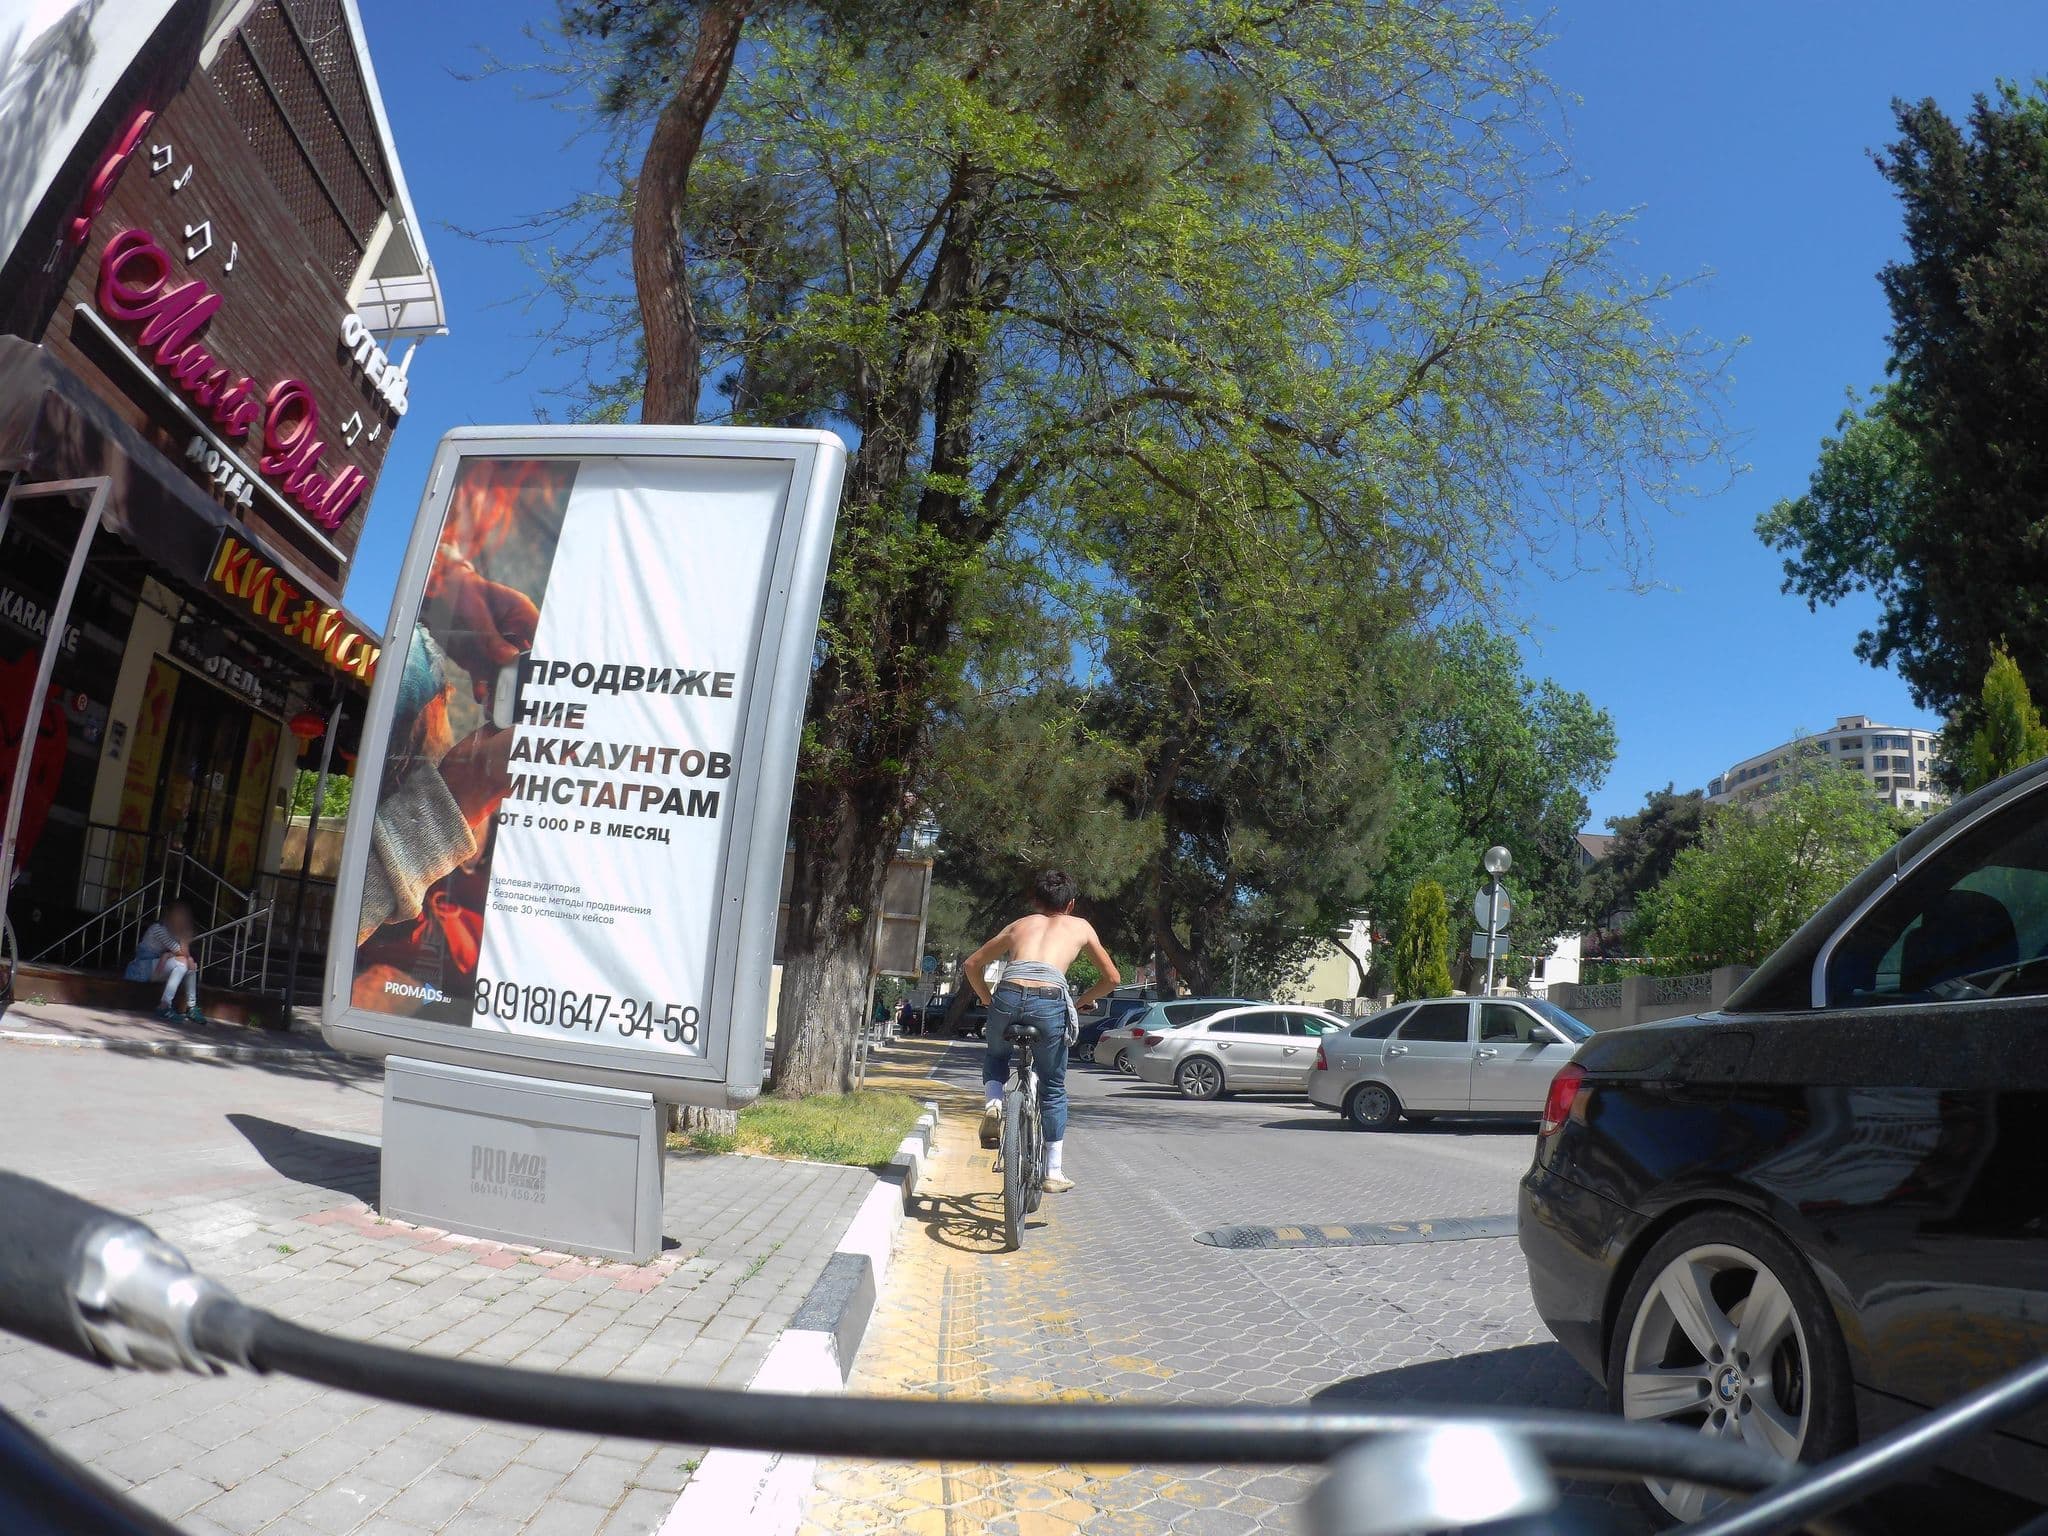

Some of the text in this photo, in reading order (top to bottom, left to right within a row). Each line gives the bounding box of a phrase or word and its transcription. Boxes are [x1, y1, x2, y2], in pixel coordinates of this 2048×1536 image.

[341, 313, 409, 416] ОТЕЛЬ
[0, 585, 81, 653] KARAKE
[527, 659, 736, 699] ПРОДВИЖЕ
[519, 699, 588, 730] НИЕ
[509, 736, 732, 780] АККАУНТОВ
[507, 773, 720, 819] ИНСТАГРАМ
[499, 812, 519, 827] ОТ
[523, 815, 533, 828] 5
[538, 817, 569, 832] 000
[590, 822, 602, 835] В
[606, 823, 671, 845] МЕСЯЦ
[493, 888, 652, 917] безопасные методы продвижения
[495, 876, 581, 894] целевая аудитория
[492, 901, 615, 926] более 30 успешных кейсов
